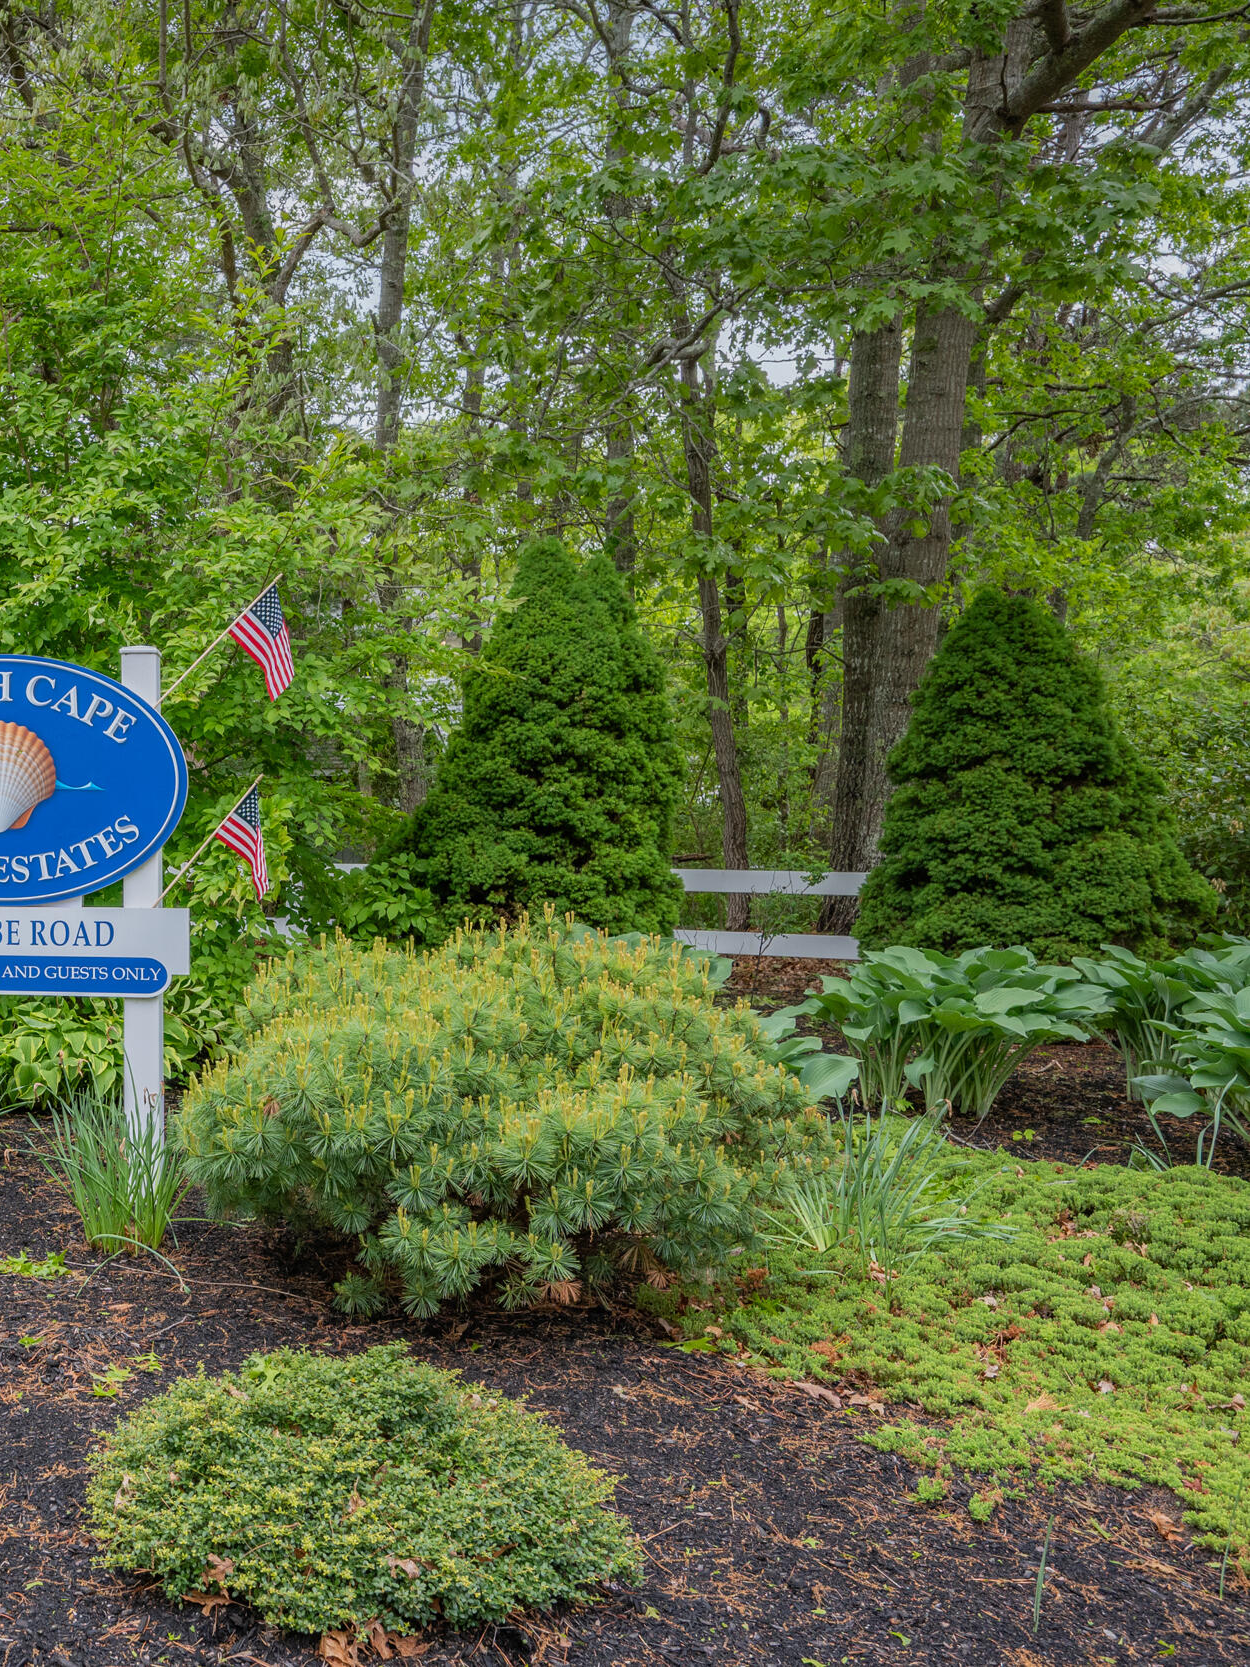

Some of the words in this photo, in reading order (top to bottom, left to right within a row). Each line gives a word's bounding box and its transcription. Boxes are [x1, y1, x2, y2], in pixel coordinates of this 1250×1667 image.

[25, 674, 138, 744] CAPE
[30, 919, 115, 947] ROAD
[1, 965, 41, 979] AND
[44, 966, 108, 980] GUESTS
[112, 967, 162, 982] ONLY
